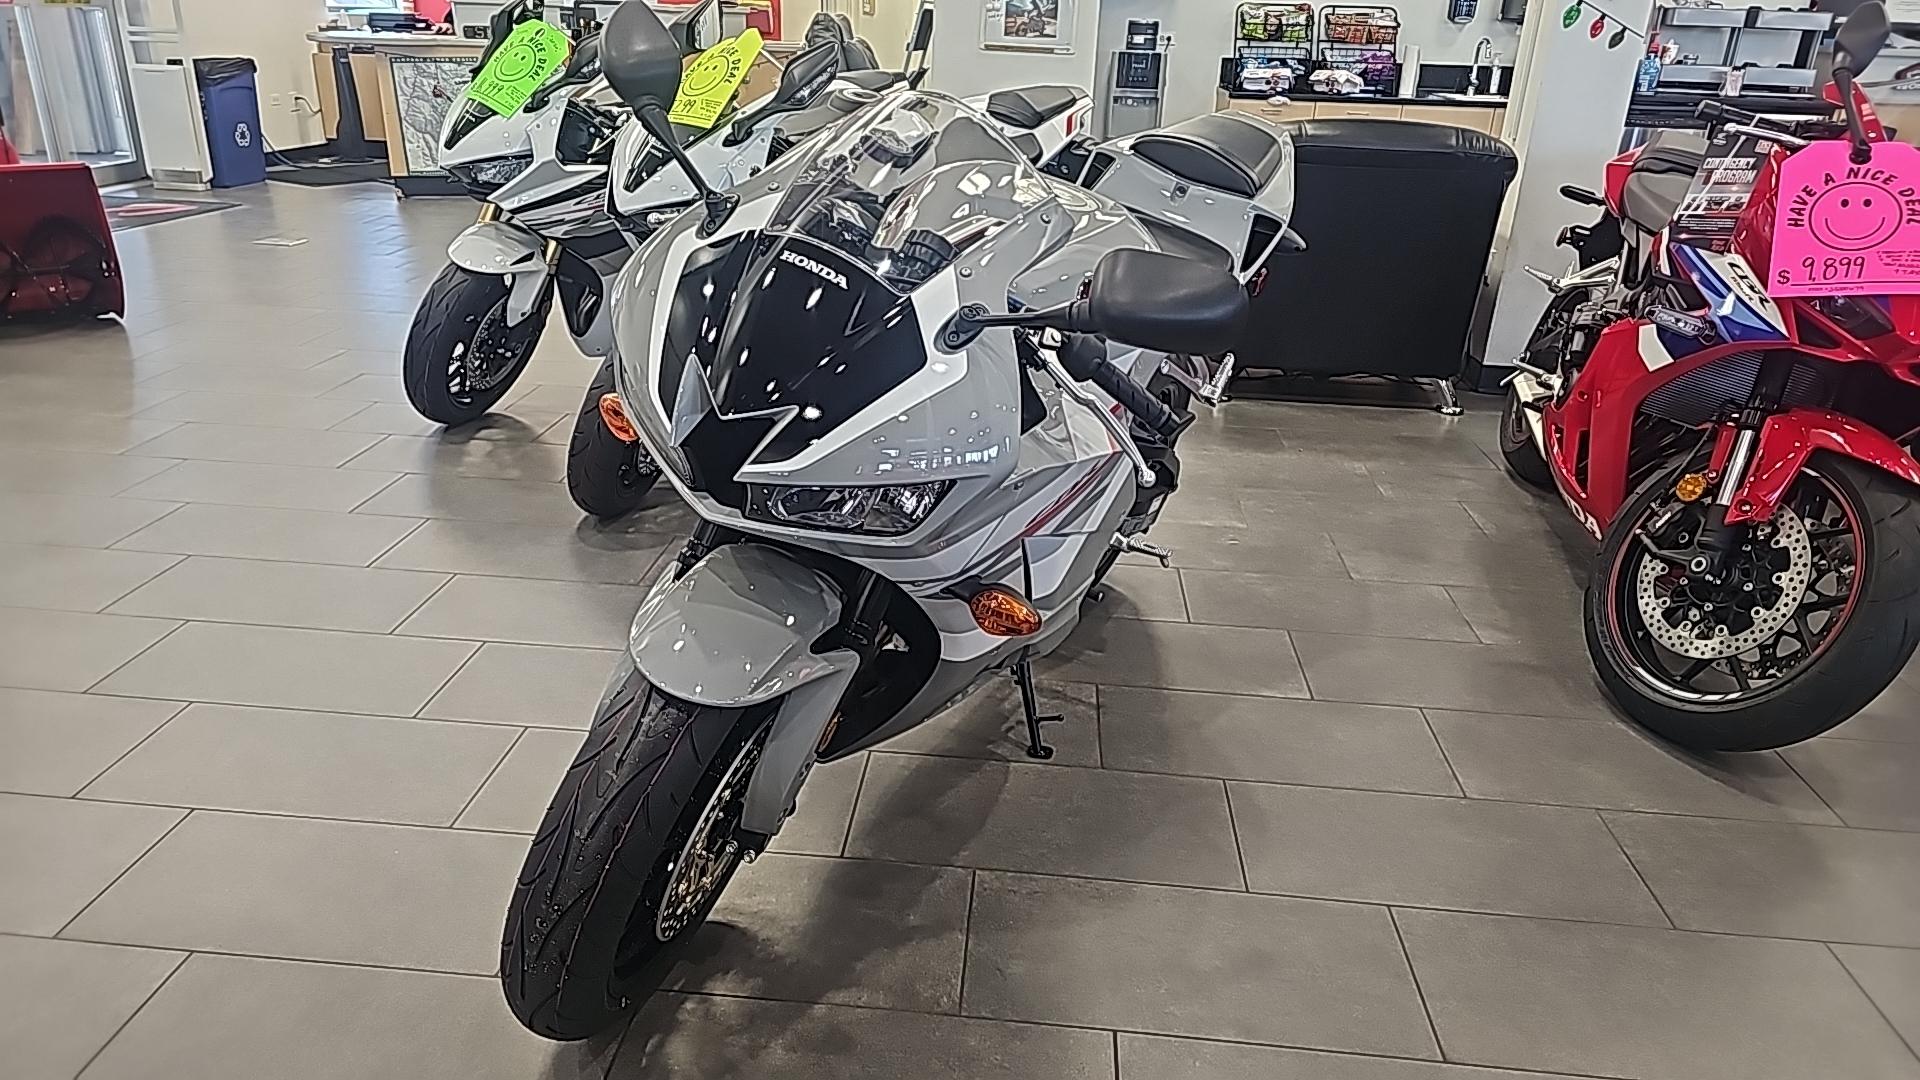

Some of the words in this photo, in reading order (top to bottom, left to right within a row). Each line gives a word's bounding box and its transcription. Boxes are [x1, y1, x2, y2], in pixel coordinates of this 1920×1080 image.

[527, 36, 547, 54] NICE
[528, 57, 548, 81] DEAL
[723, 58, 743, 85] DEAL
[1702, 157, 1758, 169] CONTINGENCY
[1711, 169, 1758, 184] PROGRAM
[1786, 185, 1818, 228] HAVE
[1823, 172, 1836, 187] A
[1846, 166, 1899, 186] NICE
[1897, 187, 1920, 225] DEAL
[779, 249, 849, 291] HONDA
